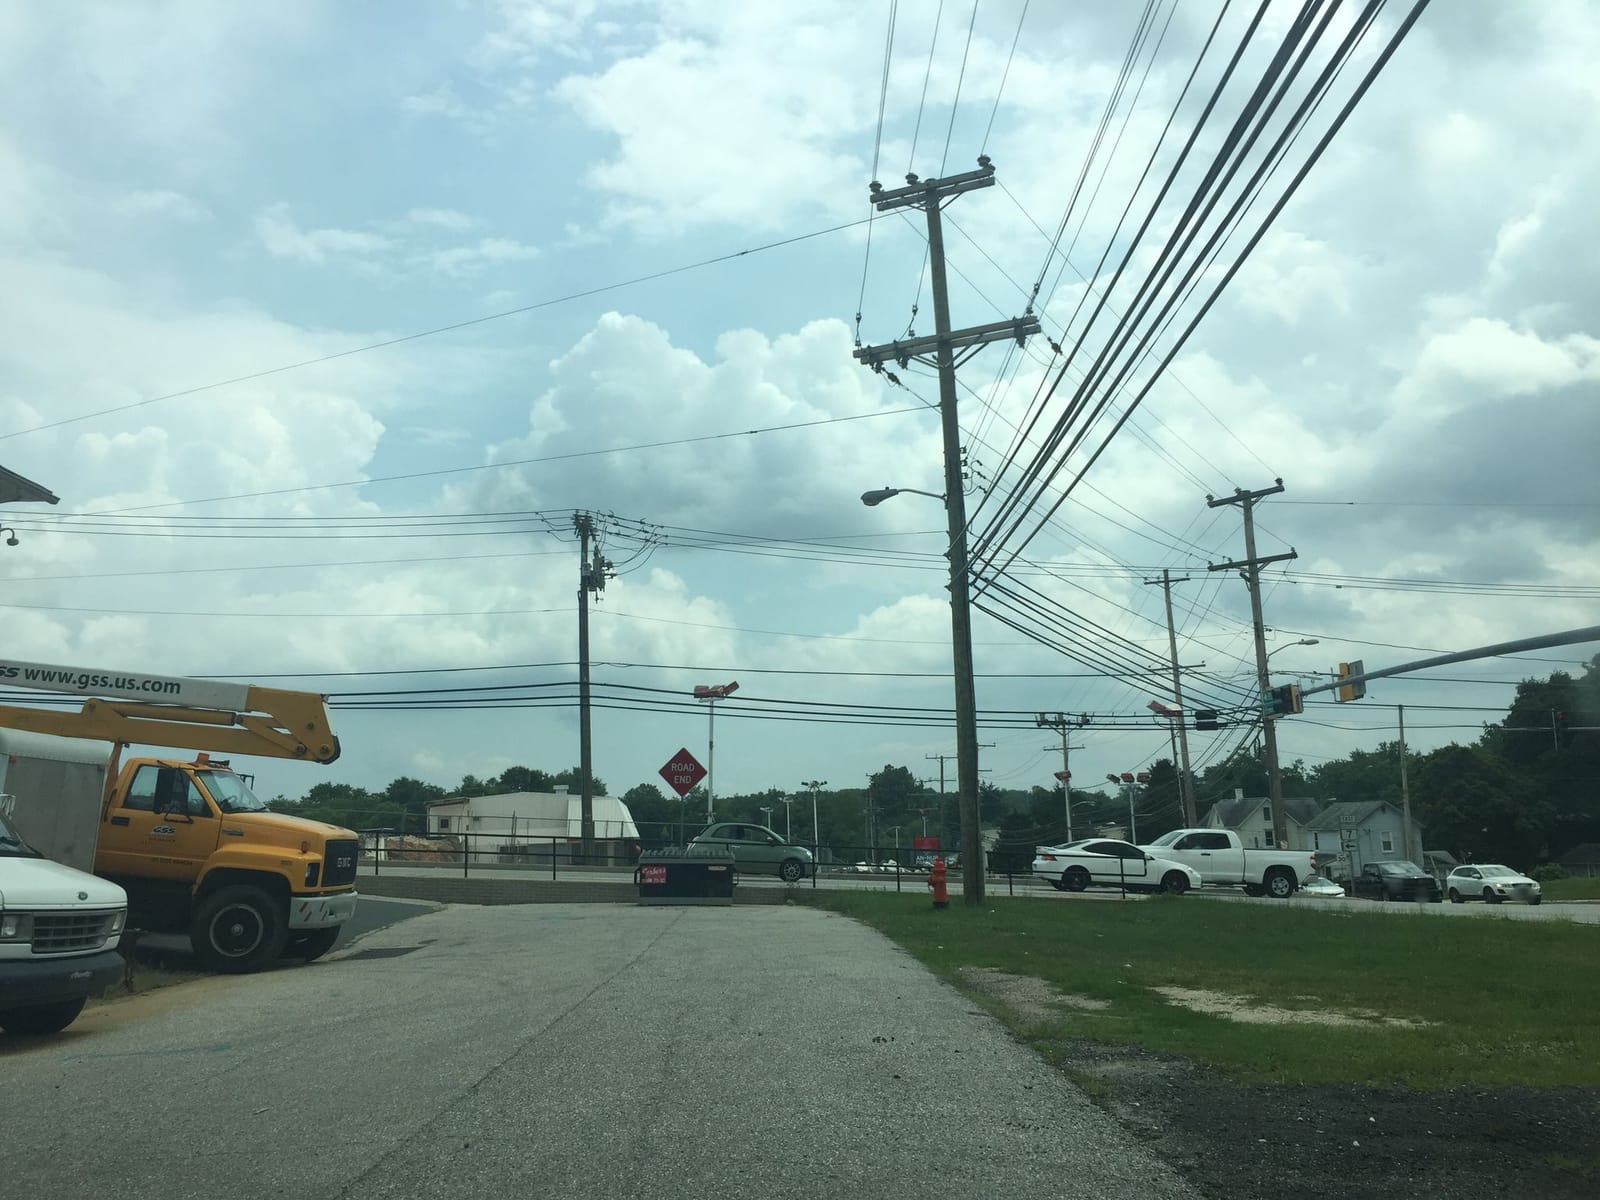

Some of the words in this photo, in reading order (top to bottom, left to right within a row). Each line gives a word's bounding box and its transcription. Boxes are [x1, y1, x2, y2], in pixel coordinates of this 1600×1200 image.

[24, 668, 181, 694] www.gss.us.com
[671, 762, 695, 772] ROAD
[674, 775, 692, 784] END
[1346, 830, 1353, 838] 7
[337, 857, 352, 868] GMC
